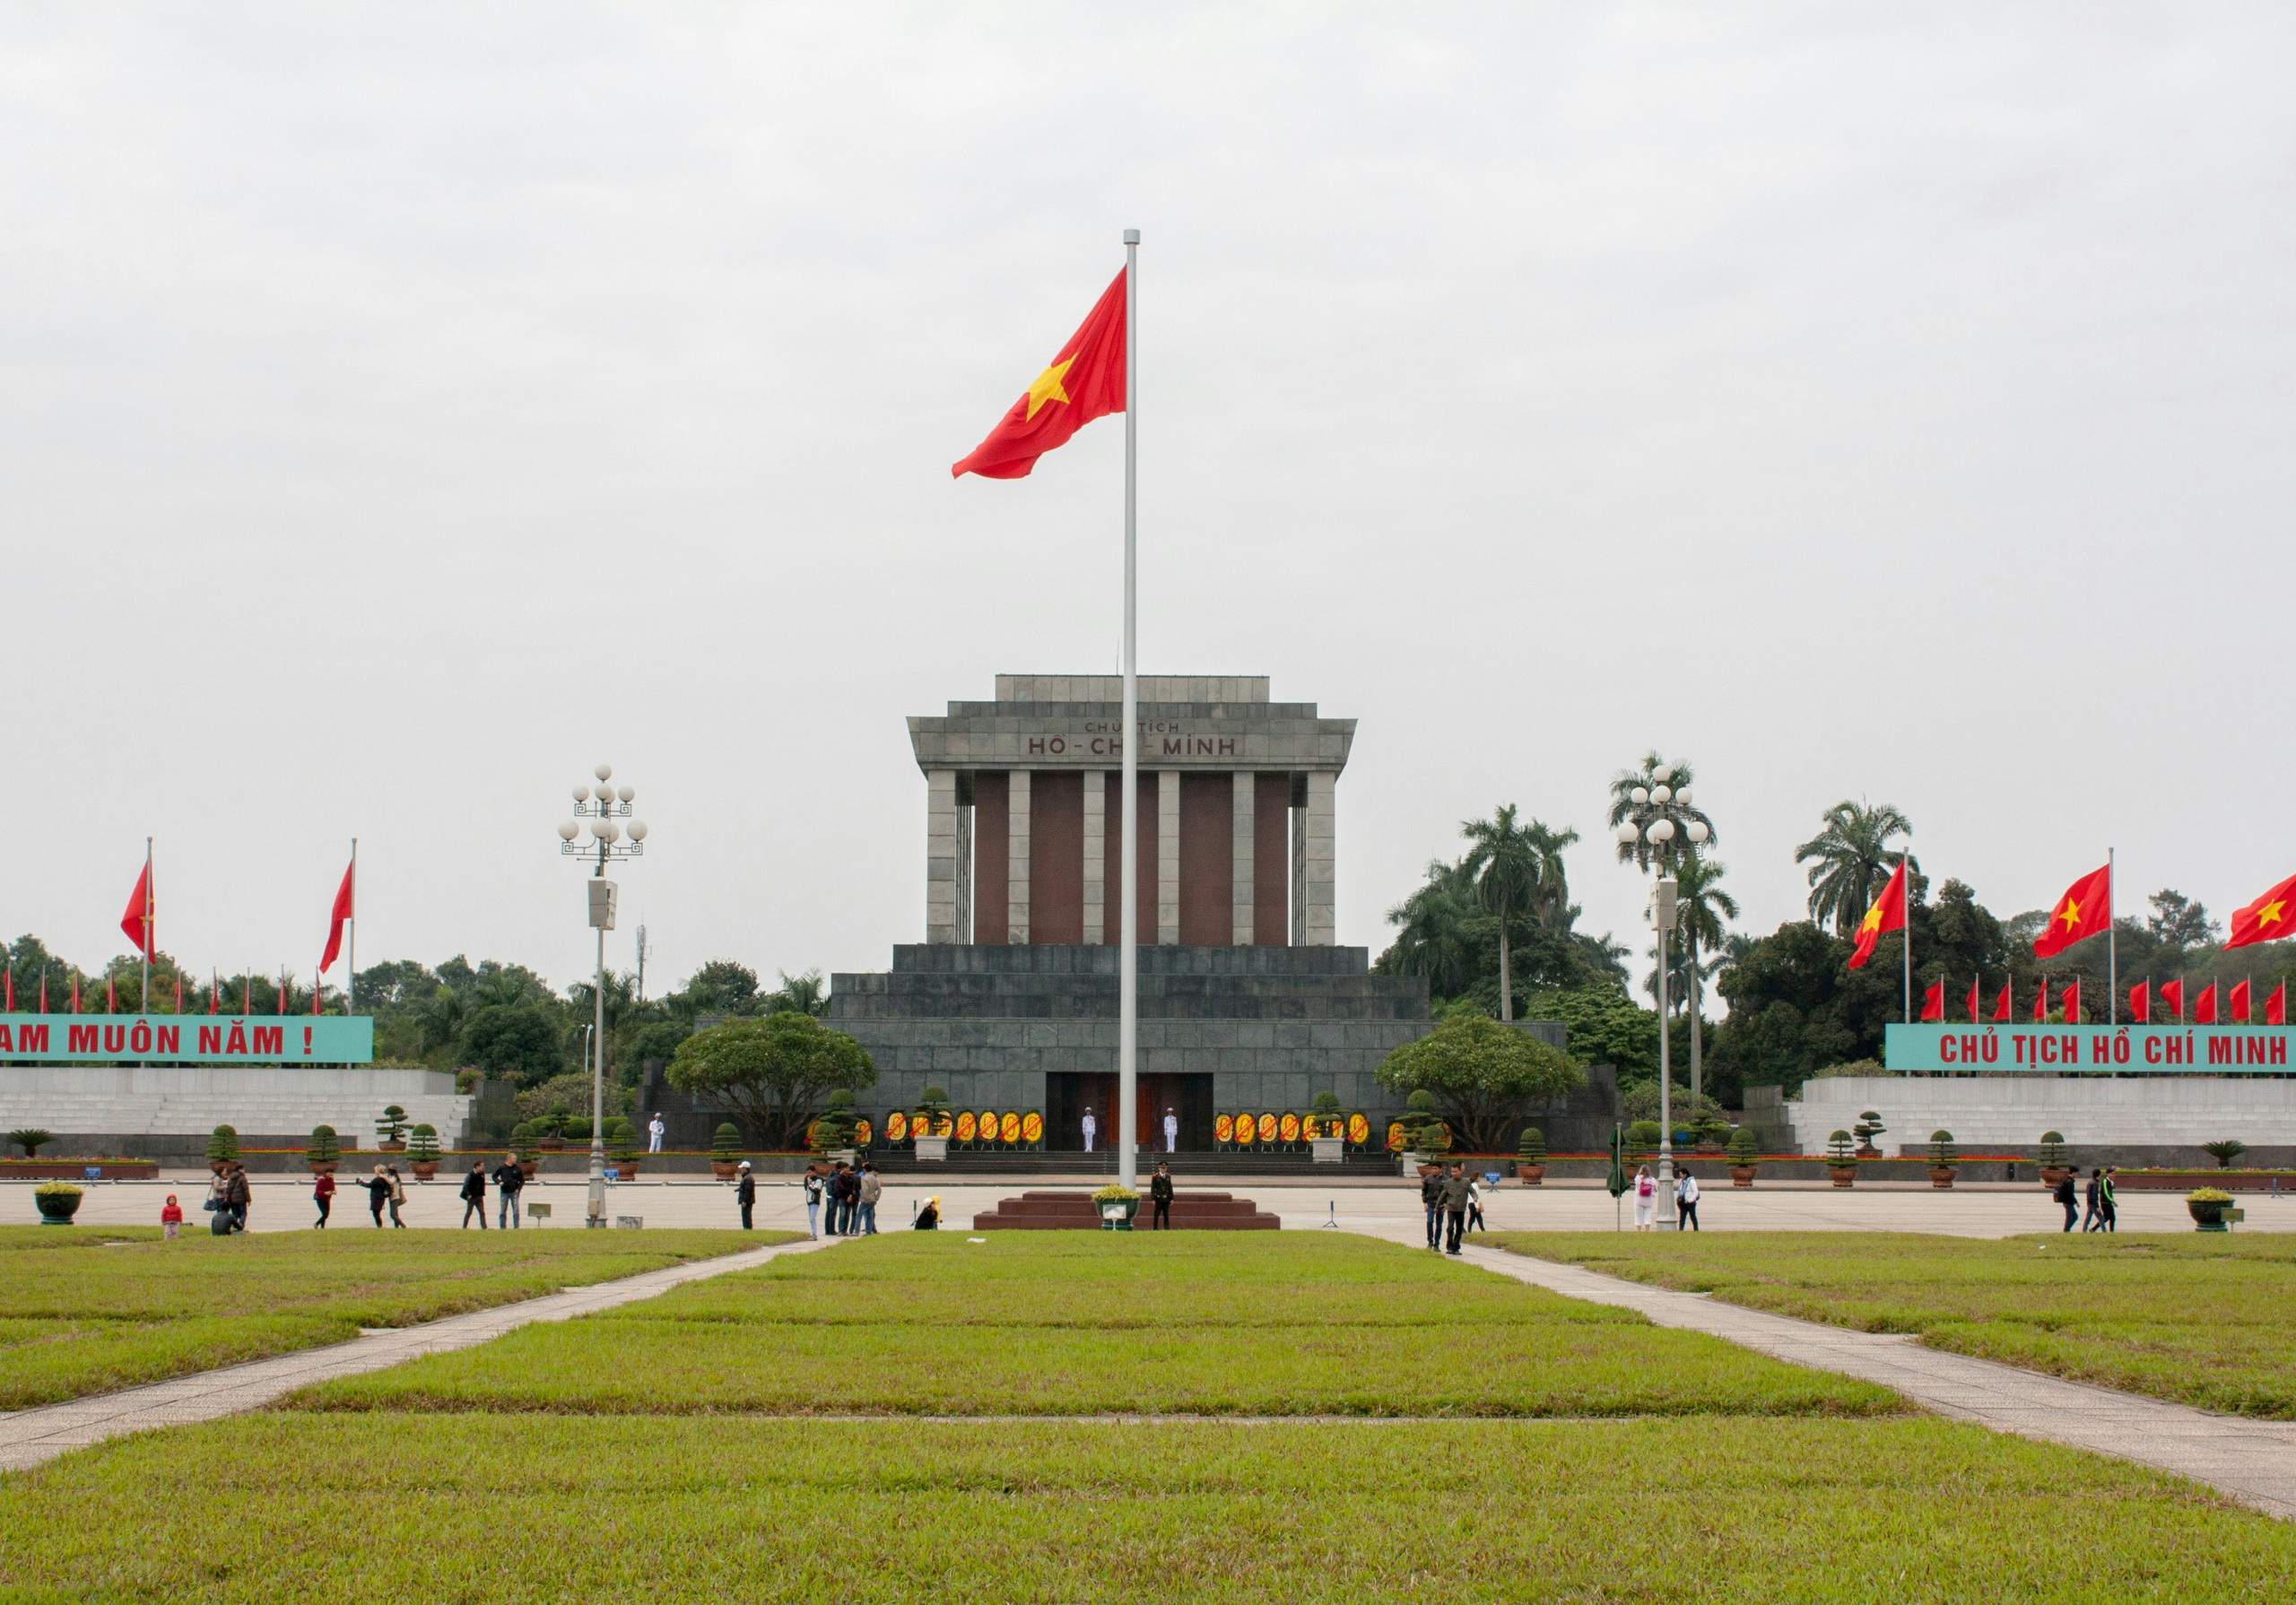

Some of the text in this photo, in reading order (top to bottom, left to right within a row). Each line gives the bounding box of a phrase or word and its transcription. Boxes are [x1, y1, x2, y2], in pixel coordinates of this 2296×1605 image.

[68, 1019, 179, 1054] MUÔN
[198, 1019, 283, 1054] NĂM
[302, 1026, 313, 1054] !
[1939, 1026, 2286, 1069] CHỦ TỊCH HỒ CHÍ MINH
